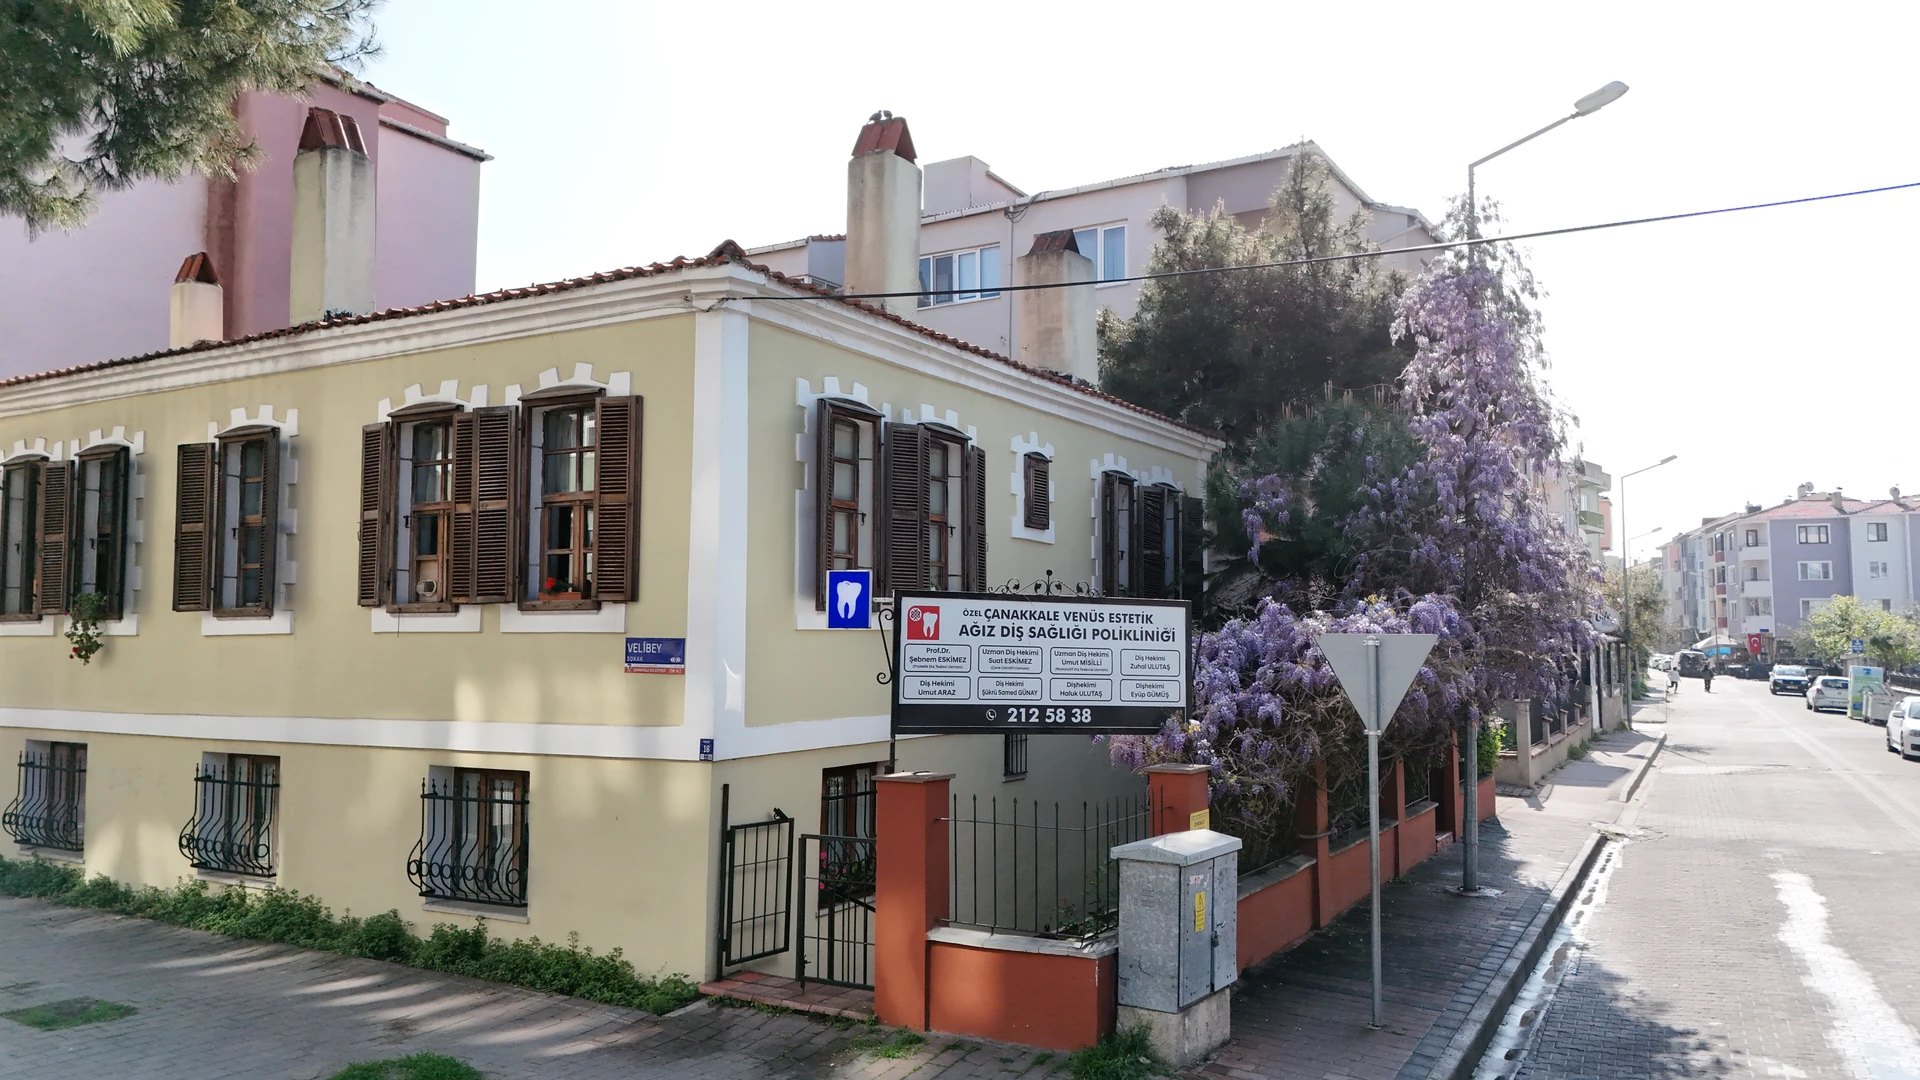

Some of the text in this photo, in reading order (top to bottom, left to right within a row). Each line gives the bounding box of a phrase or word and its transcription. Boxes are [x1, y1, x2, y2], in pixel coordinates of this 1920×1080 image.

[962, 608, 1154, 624] ÖZEL ÇANAKKALE VENÜS ESTETİK
[959, 622, 1176, 642] AĞIZ DİŞ SAĞLIĞI POLİKLİNİĞİ
[628, 641, 662, 654] VELİBEY
[1007, 708, 1092, 723] 212 58 38
